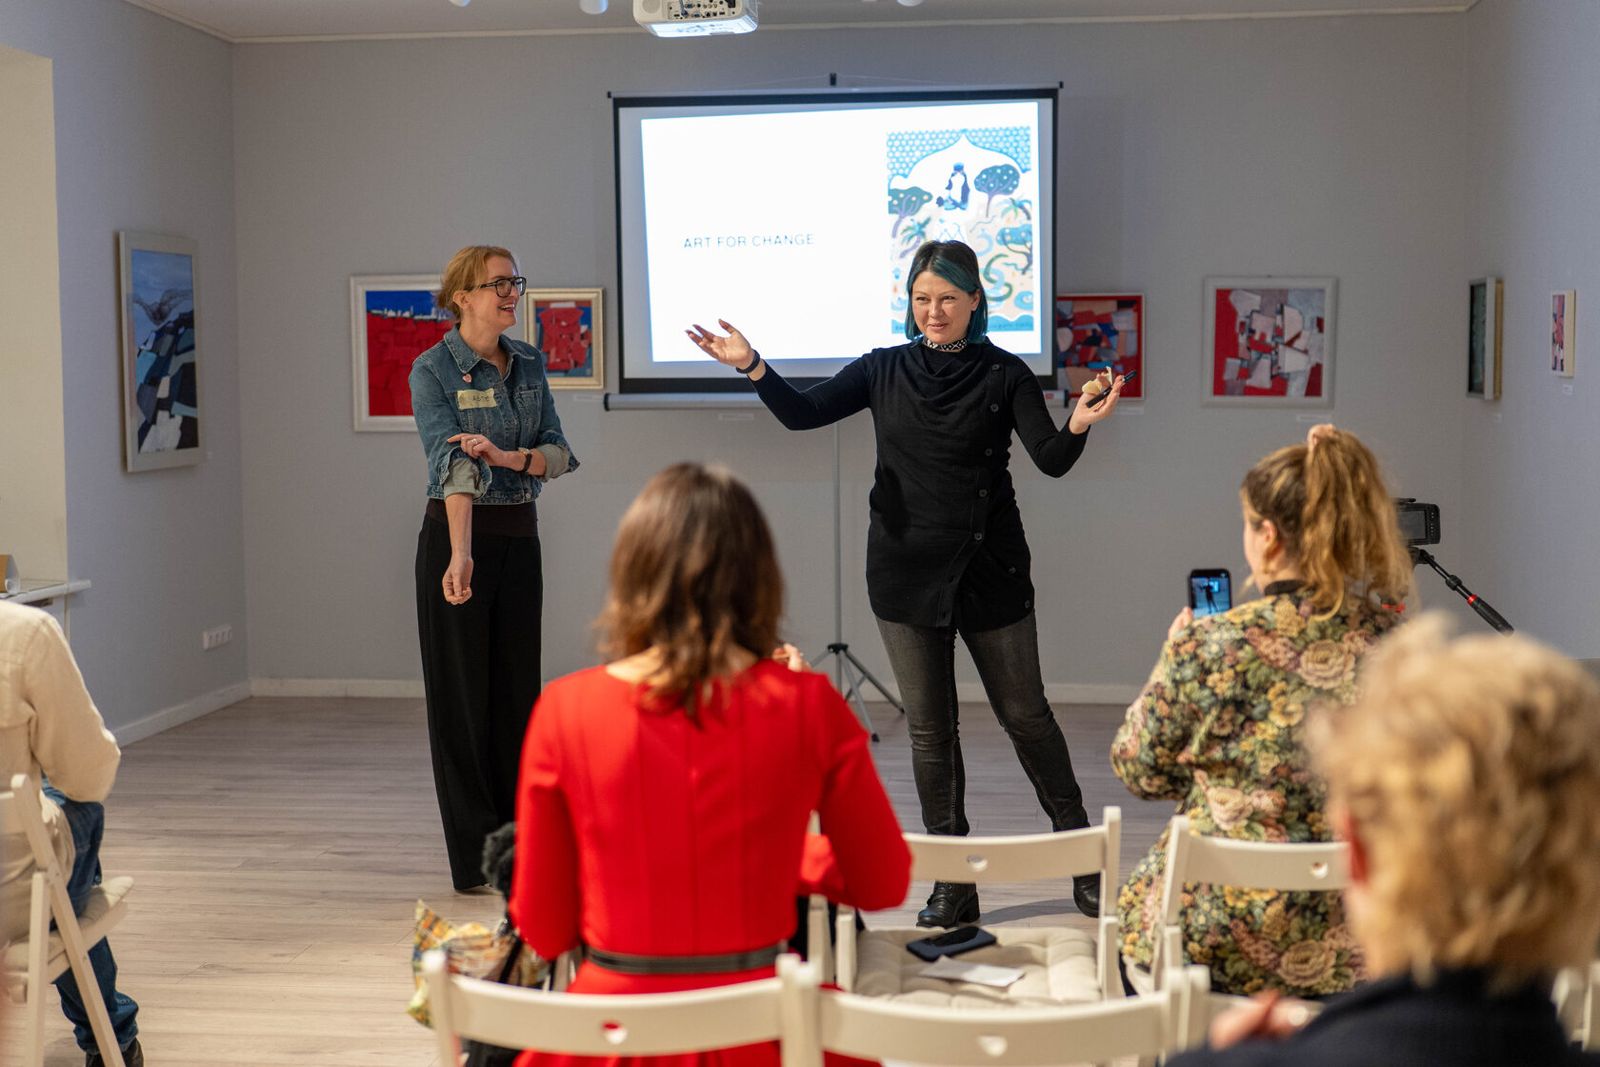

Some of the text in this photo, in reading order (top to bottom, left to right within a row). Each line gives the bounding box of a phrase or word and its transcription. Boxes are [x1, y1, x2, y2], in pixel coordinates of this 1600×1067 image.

[684, 233, 815, 248] ART FOR CHANGE
